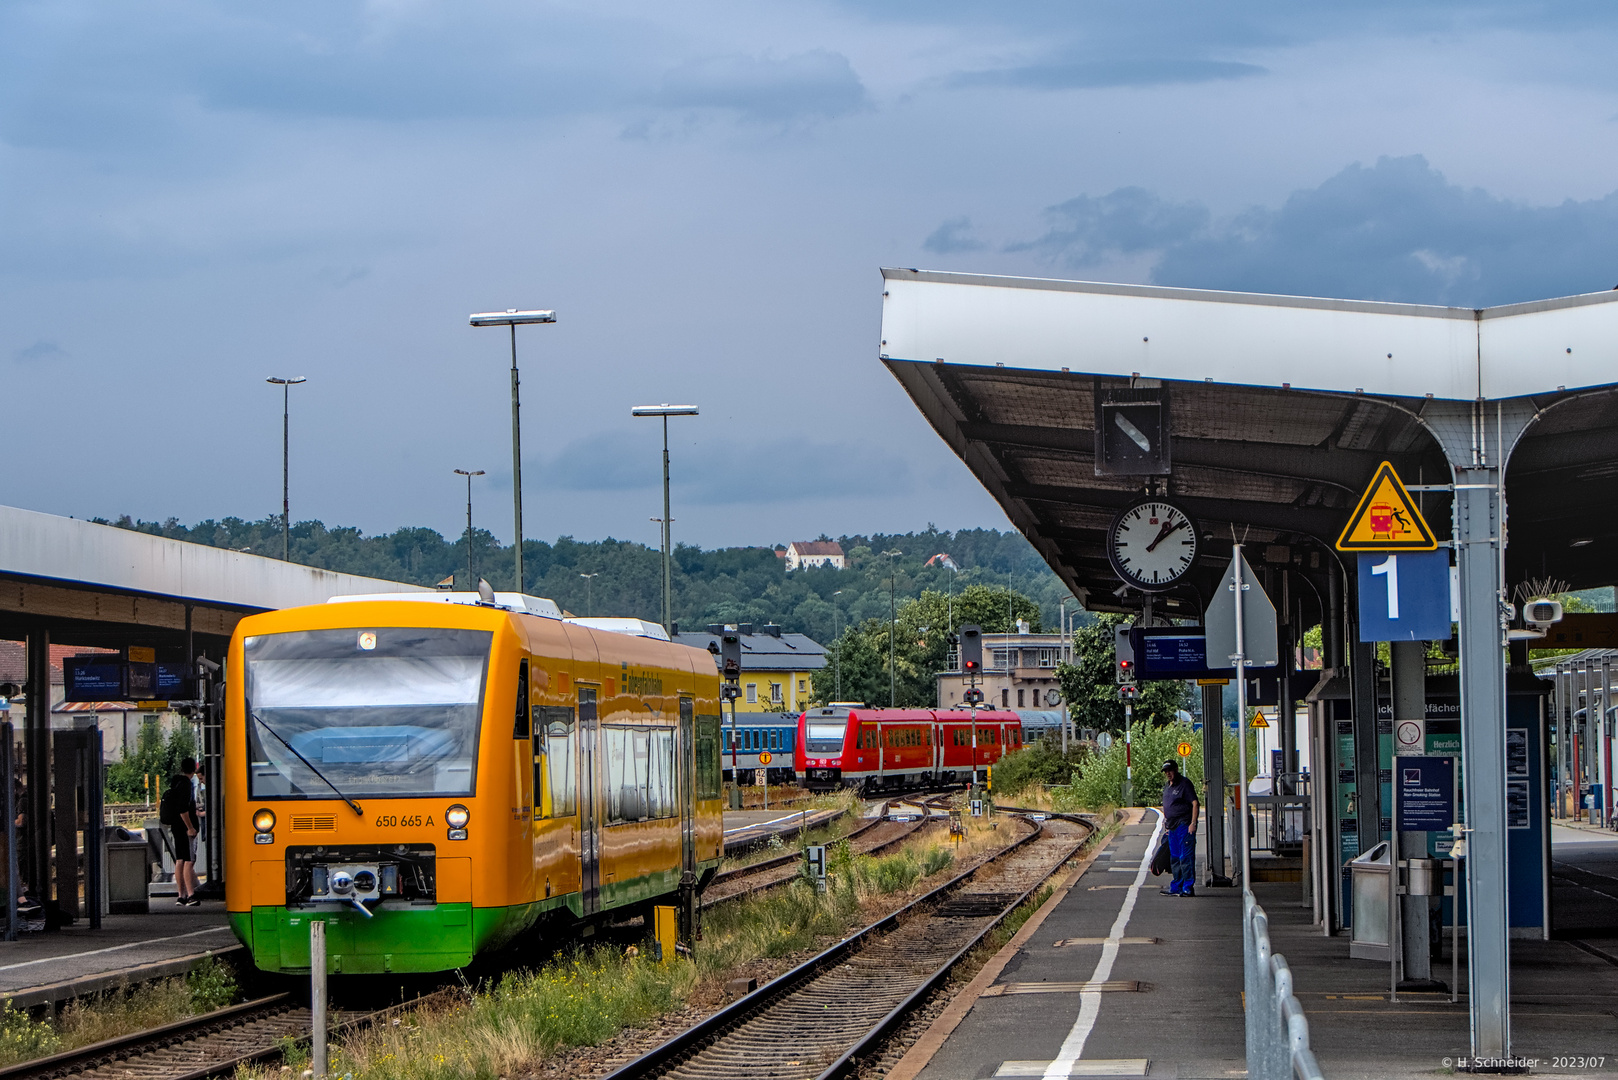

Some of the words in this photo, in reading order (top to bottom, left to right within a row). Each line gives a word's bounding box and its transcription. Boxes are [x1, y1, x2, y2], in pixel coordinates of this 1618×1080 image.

[1372, 555, 1399, 619] 1
[1250, 678, 1261, 699] 1
[1433, 740, 1460, 749] Herzlich
[758, 777, 764, 785] 8
[972, 801, 981, 815] H
[375, 815, 397, 827] 650
[400, 815, 422, 827] 665
[425, 815, 435, 827] A
[807, 848, 823, 875] H
